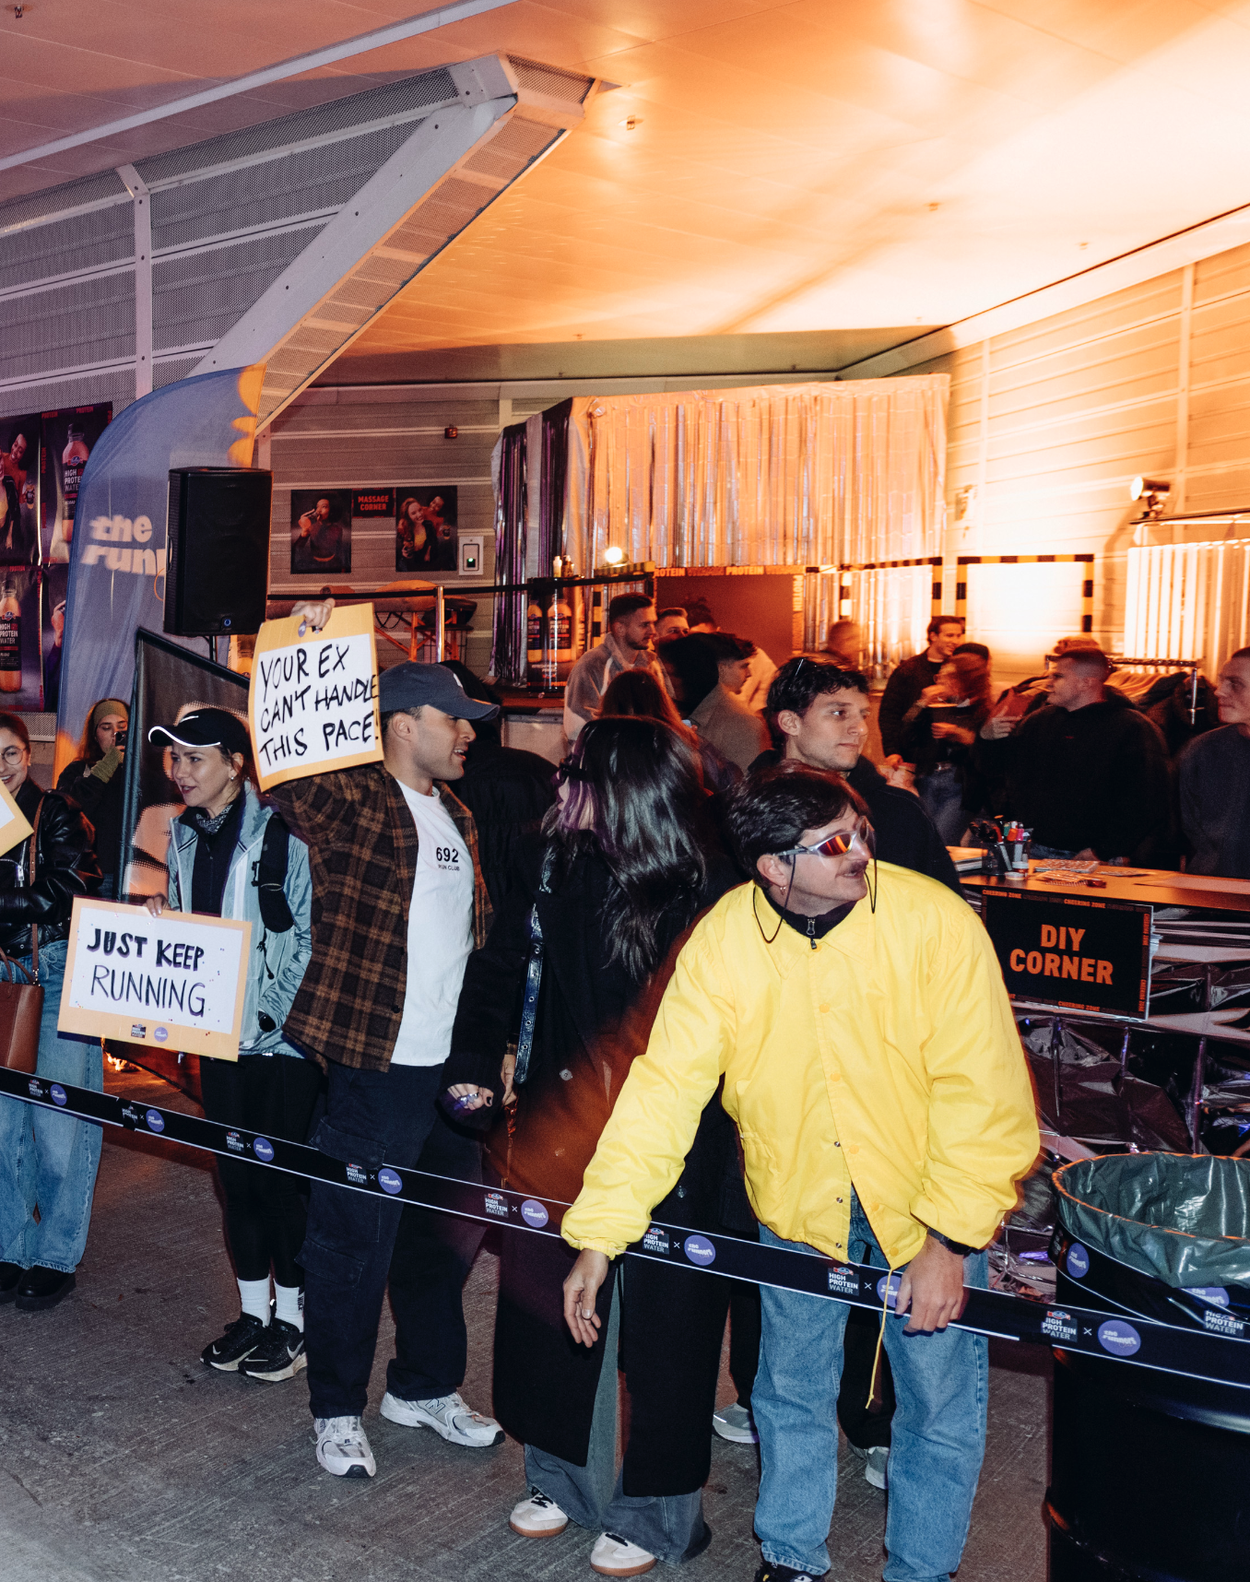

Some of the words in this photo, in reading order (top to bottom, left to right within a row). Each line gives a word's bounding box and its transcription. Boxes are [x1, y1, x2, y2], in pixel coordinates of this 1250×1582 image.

[64, 476, 81, 484] PROTE
[358, 495, 389, 503] MASSAGE
[360, 503, 386, 511] CORNER
[89, 514, 153, 543] the
[654, 568, 686, 577] ROTEIN
[726, 566, 764, 576] PROTEIN
[792, 575, 804, 612] PROTEIN
[261, 648, 309, 703] YOUR
[318, 644, 349, 678] EX
[314, 674, 379, 711] HANDLE
[259, 728, 308, 766] THIS
[436, 847, 459, 862] 692
[1064, 898, 1090, 906] CHEERING
[1040, 924, 1086, 952] DIY
[86, 928, 148, 958] JUST
[155, 939, 205, 972] KEEP
[1010, 948, 1114, 985] CORNER
[90, 964, 206, 1018] RUNNING
[1058, 1000, 1084, 1010] CHEERING
[486, 1202, 508, 1212] PROTEIN
[486, 1208, 504, 1216] WATER
[644, 1239, 669, 1249] PROTEIN
[644, 1244, 665, 1253] WATER
[829, 1272, 846, 1280] HIGH
[829, 1278, 858, 1289] PROTEIN
[830, 1284, 853, 1294] WATER
[1042, 1322, 1076, 1335] PROTEIN
[1206, 1316, 1243, 1330] PROTEIN
[1206, 1322, 1236, 1334] WATER
[1043, 1328, 1070, 1340] WATER
